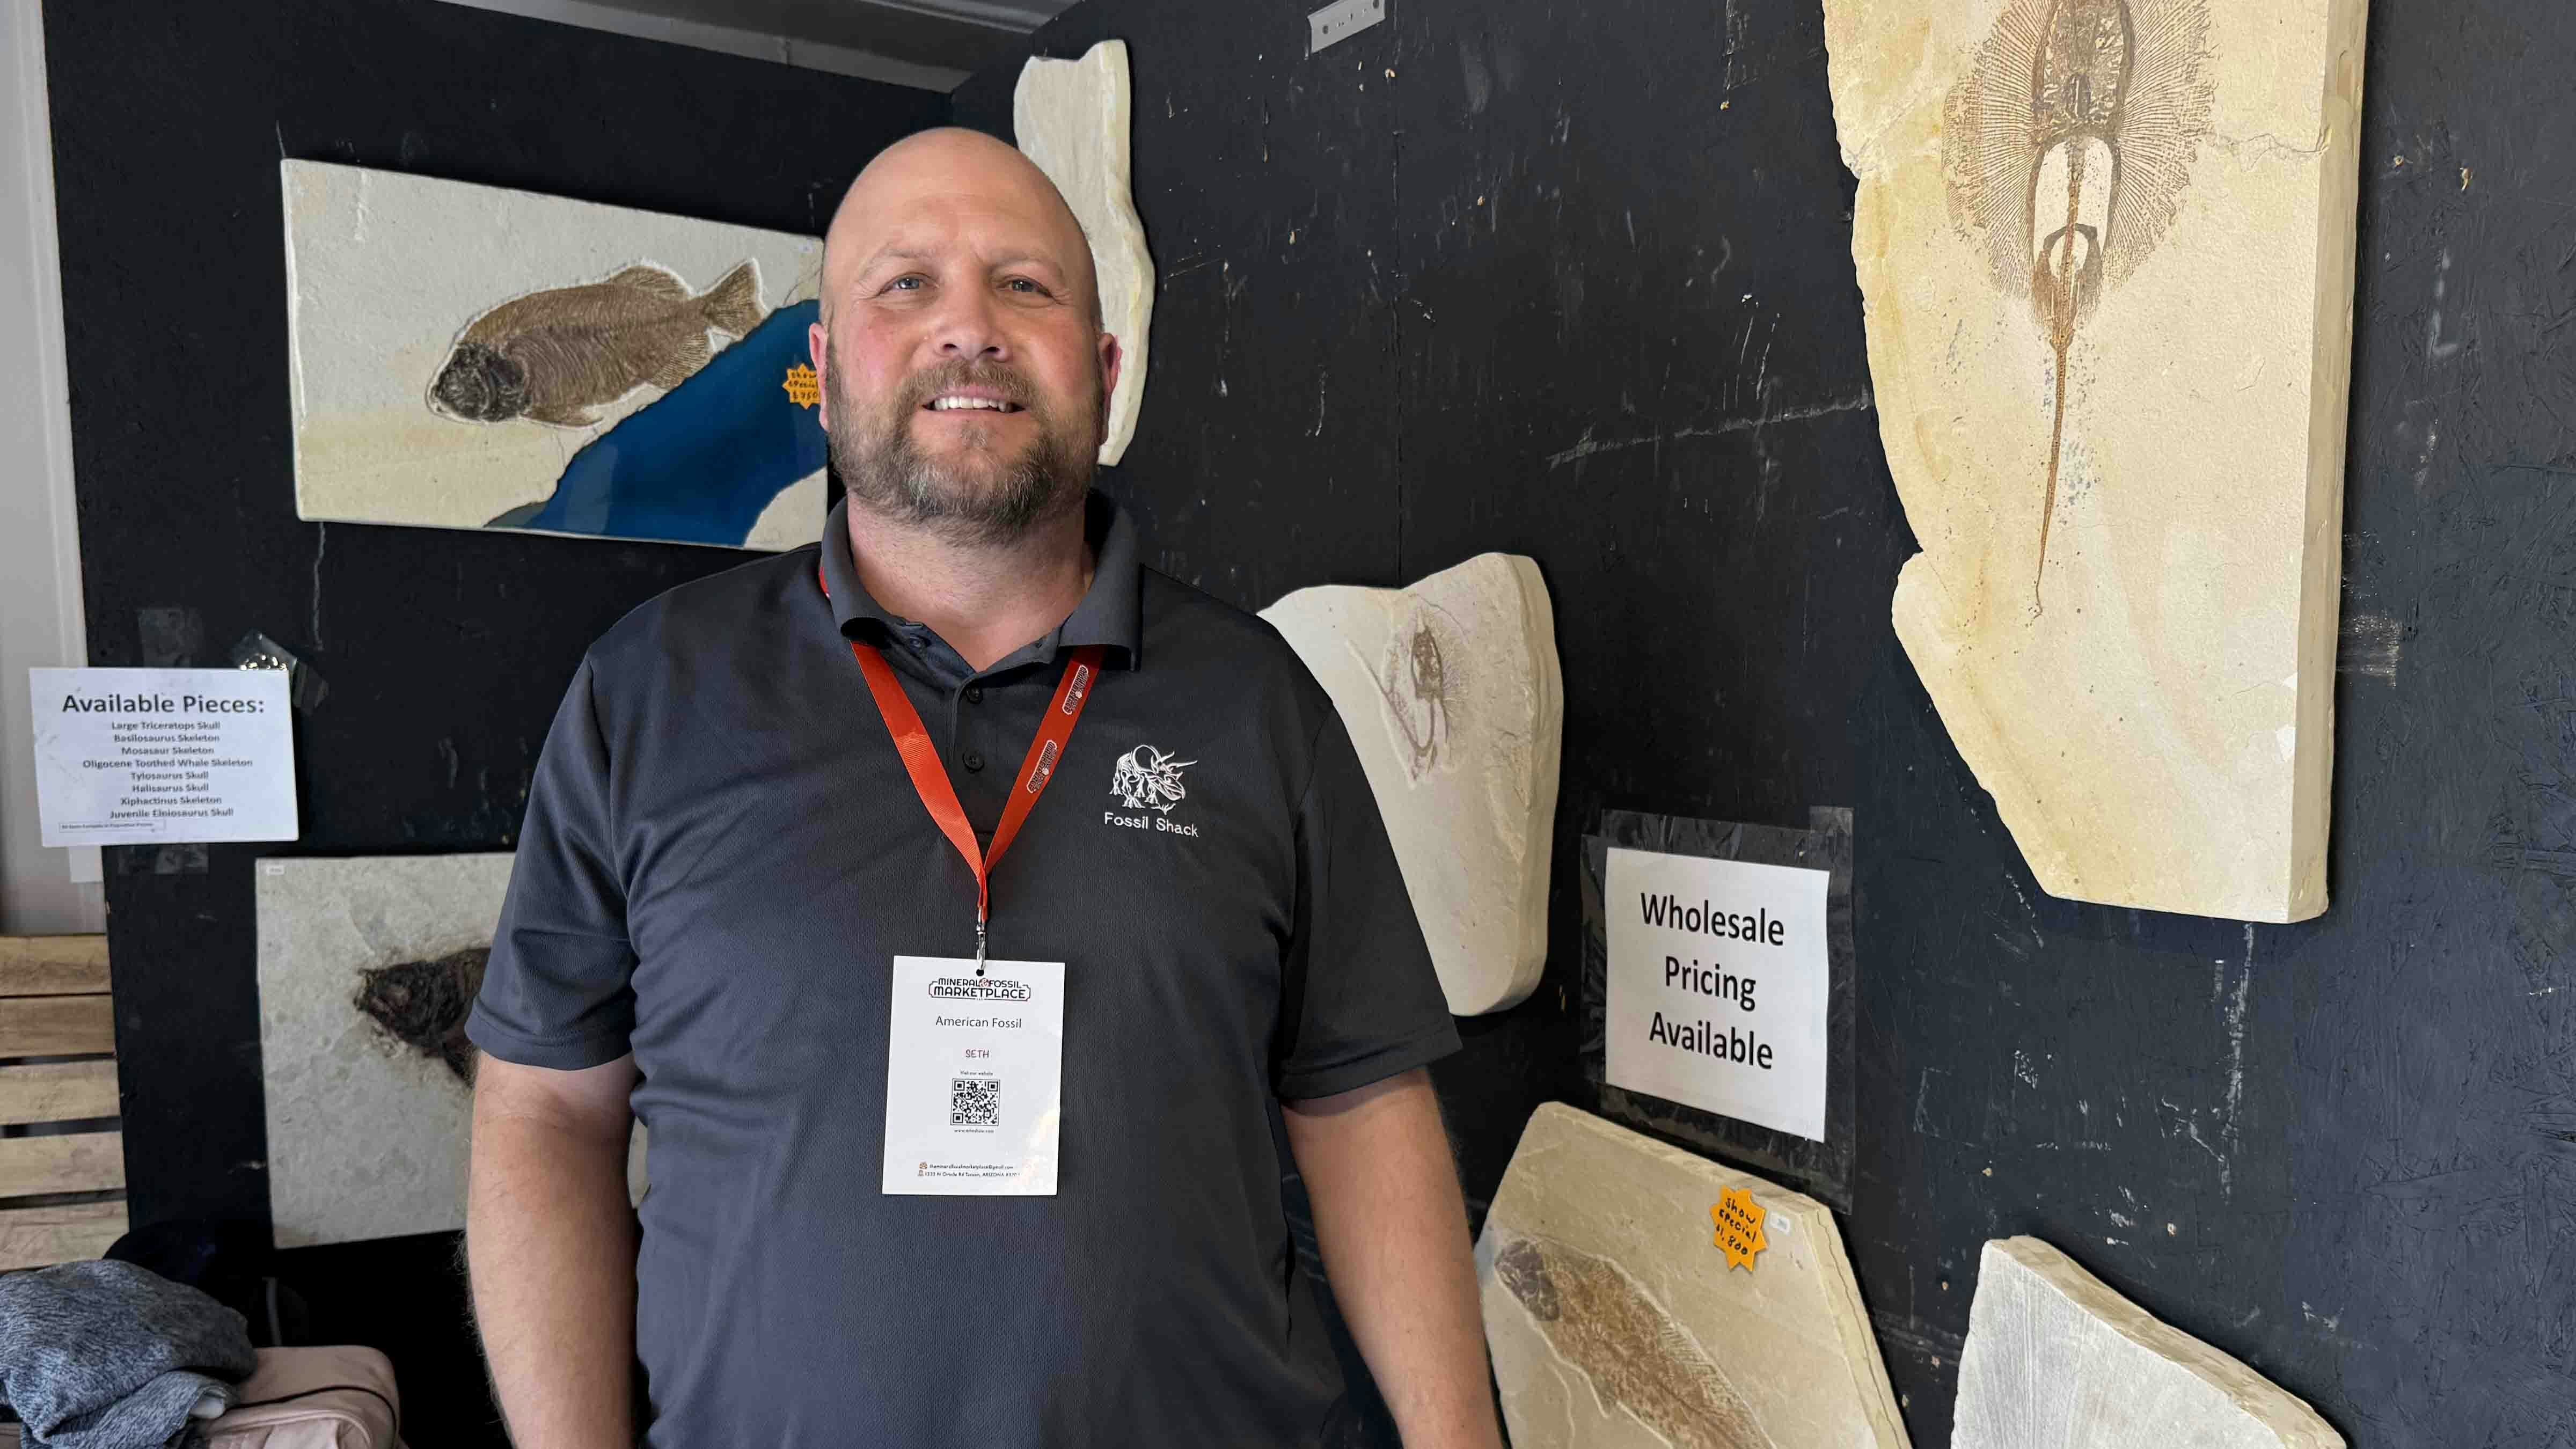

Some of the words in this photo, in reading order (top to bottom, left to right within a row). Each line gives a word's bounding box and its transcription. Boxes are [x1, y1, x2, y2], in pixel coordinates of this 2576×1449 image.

[62, 694, 175, 713] Available
[183, 696, 265, 713] Pieces:
[112, 722, 138, 731] Large
[141, 721, 195, 731] Triceratops
[197, 721, 221, 730] Skull
[114, 734, 175, 742] Basilosaurus
[179, 734, 219, 742] Skeleton
[172, 747, 214, 755] Skeleton
[83, 759, 132, 769] Oligocene
[135, 759, 175, 767] Toothed
[178, 759, 209, 767] Whale
[211, 758, 253, 766] Skeleton
[130, 772, 182, 781] Tylosaurus
[185, 771, 209, 779] Skull
[121, 797, 178, 806] Xiphactinus
[180, 796, 222, 804] Skeleton
[110, 810, 150, 819] Juvenile
[210, 808, 233, 816] Skull
[1104, 811, 1148, 830] Fossil
[1156, 817, 1199, 838] Shack
[1640, 892, 1784, 946] Wholesale
[1665, 956, 1757, 1012] Pricing
[934, 986, 1026, 999] MARKETPLACE
[935, 1016, 989, 1028] American
[992, 1018, 1022, 1028] Fossil
[1649, 1012, 1773, 1070] Available
[965, 1050, 990, 1058] SETH
